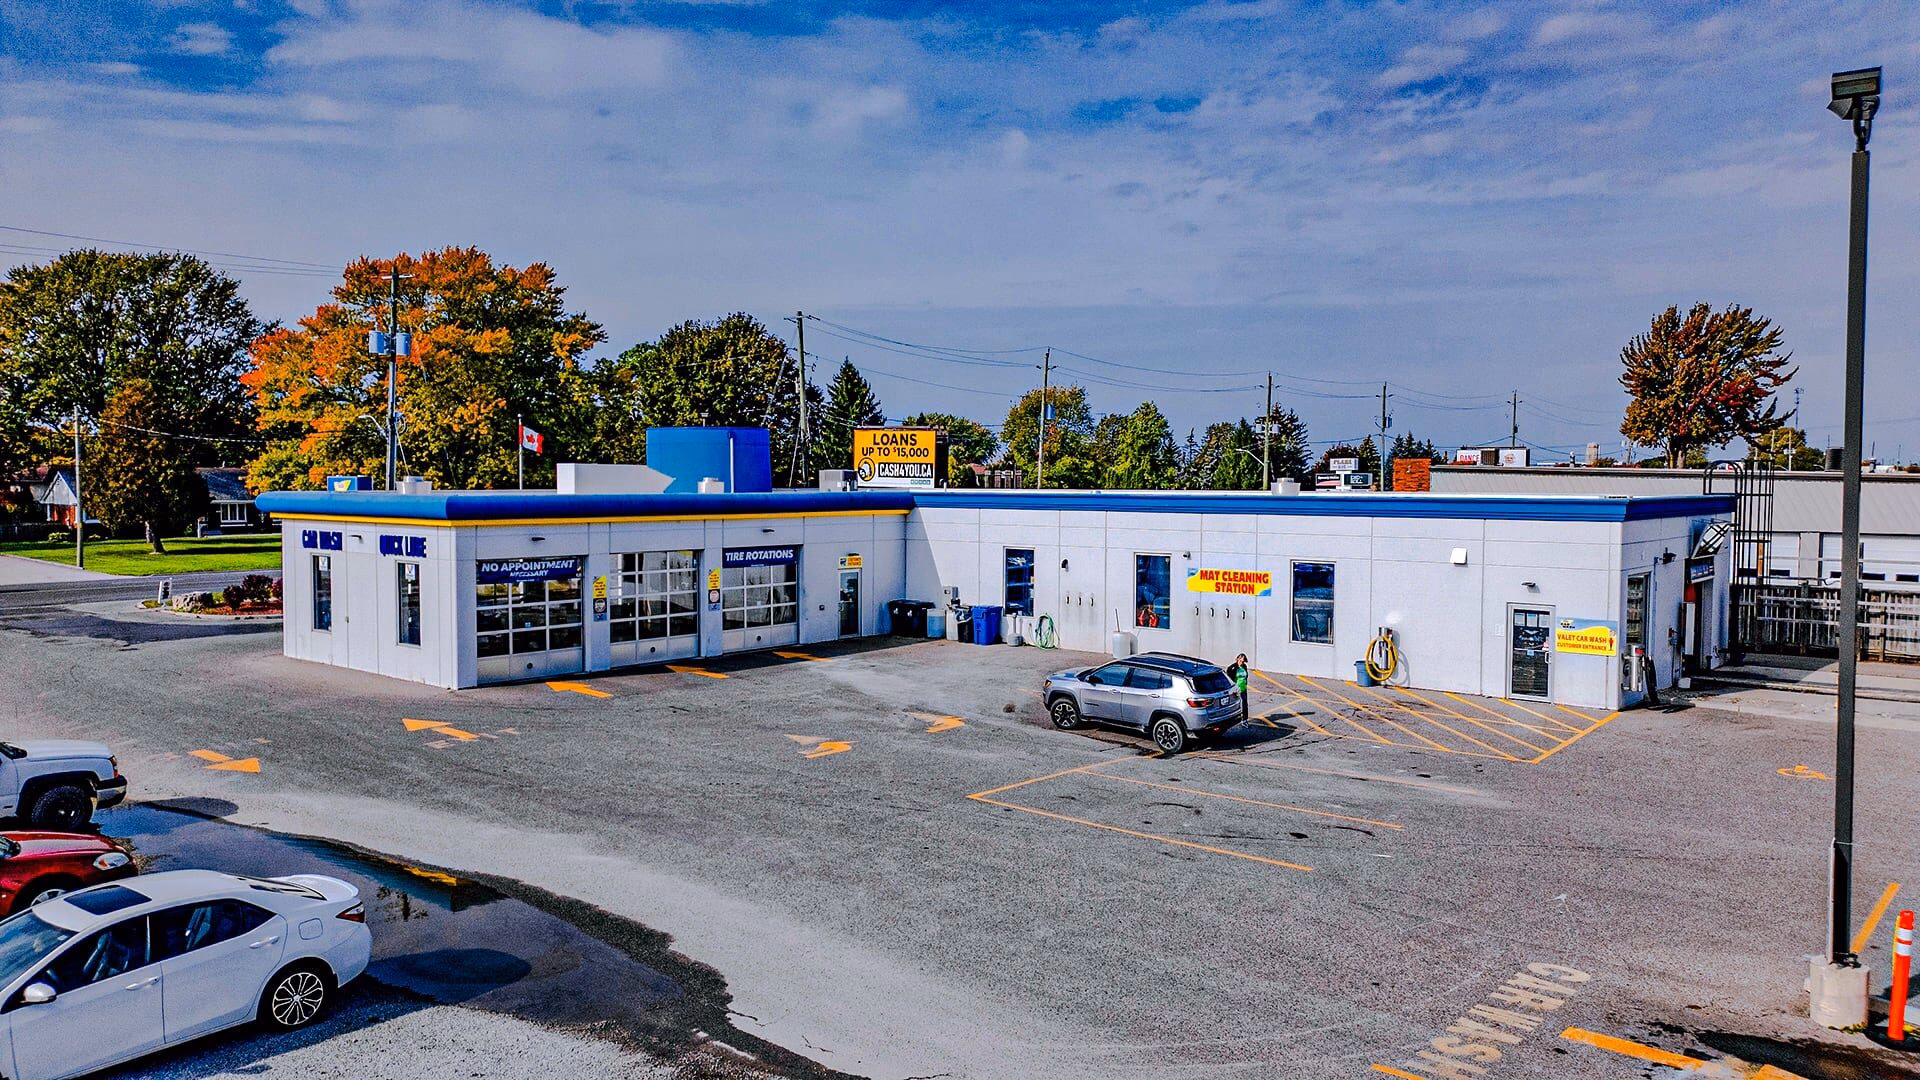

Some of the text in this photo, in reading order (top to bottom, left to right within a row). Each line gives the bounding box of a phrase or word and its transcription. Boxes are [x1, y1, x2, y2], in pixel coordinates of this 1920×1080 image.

[873, 434, 917, 446] LOANS
[862, 447, 929, 458] UP TO $15,000
[880, 464, 932, 477] CASH4YOU.CA
[726, 550, 794, 562] TIRE ROTATIONS
[482, 560, 574, 572] NO APPOINTMENT
[1200, 570, 1269, 584] MAT CLEANING
[1215, 582, 1255, 594] STATION
[1489, 962, 1591, 1010] CAR
